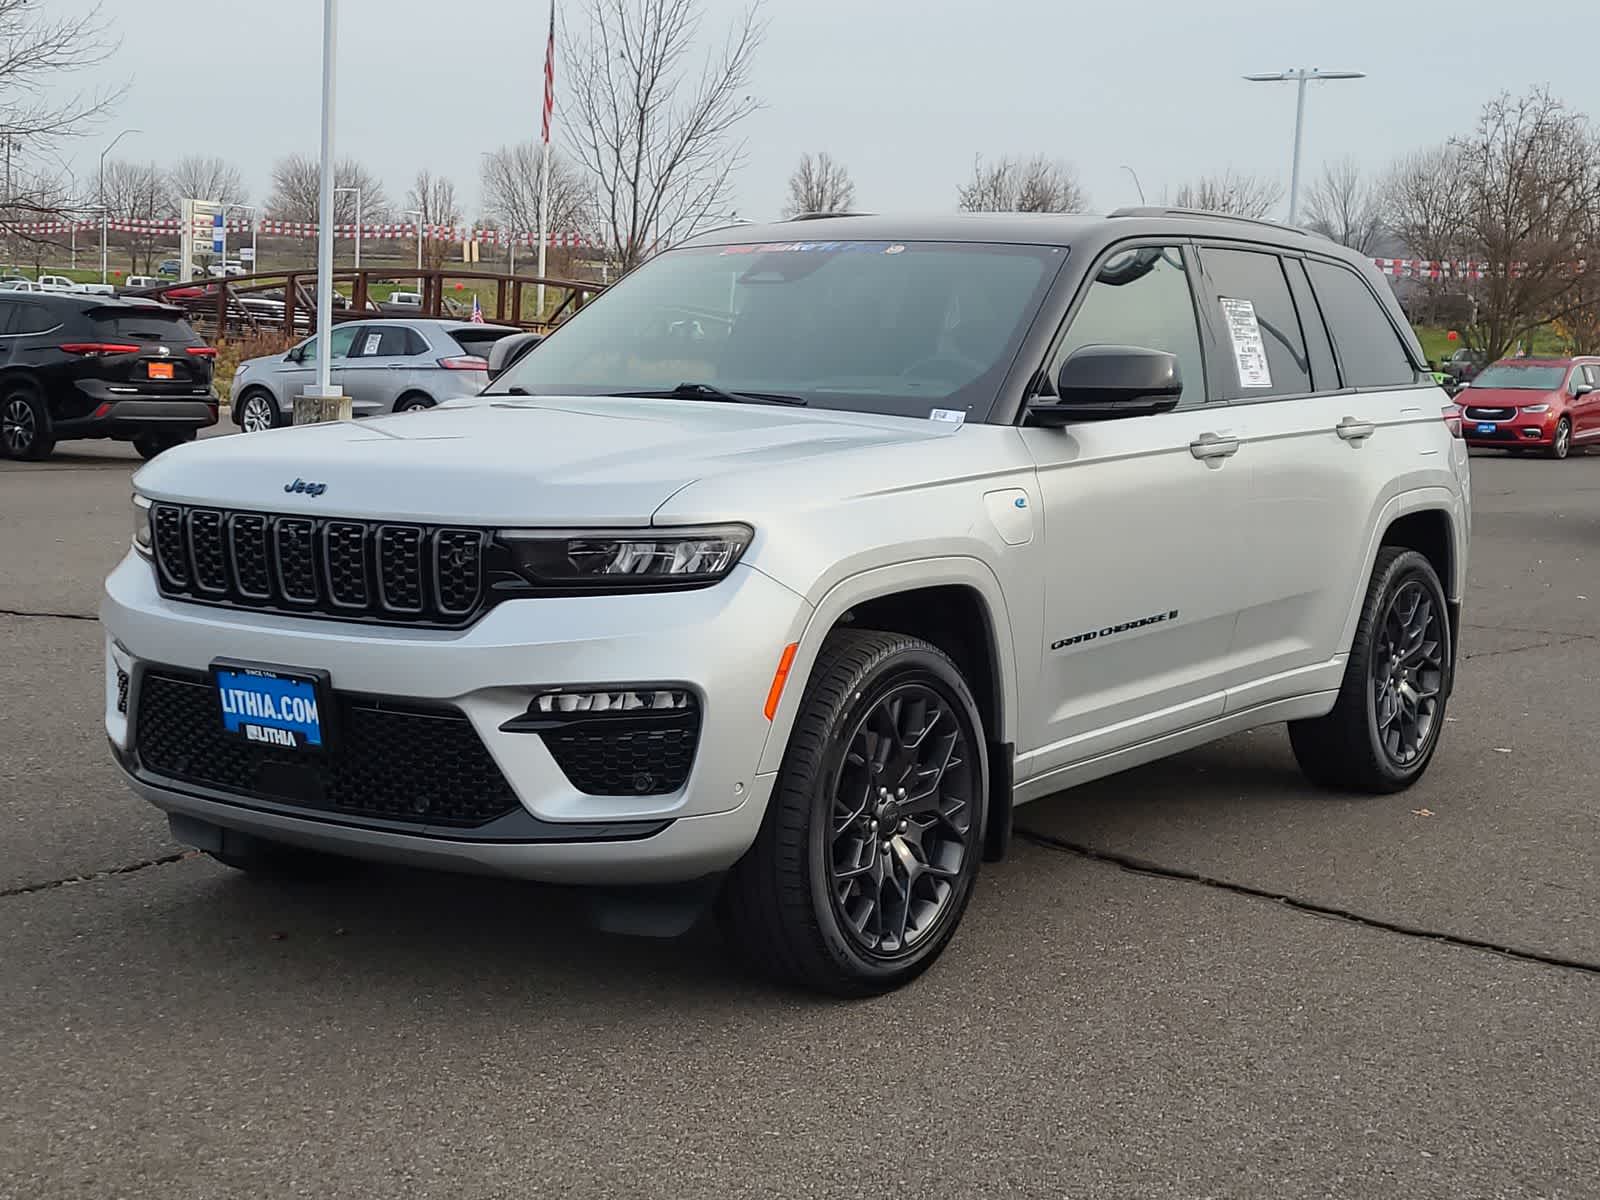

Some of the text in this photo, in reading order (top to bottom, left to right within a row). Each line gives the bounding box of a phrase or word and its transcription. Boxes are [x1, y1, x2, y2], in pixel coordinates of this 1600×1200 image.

[284, 478, 327, 498] Jeep
[1051, 612, 1167, 650] GRAND CHEROKEE
[220, 687, 319, 725] LITHIA.COM
[256, 726, 296, 747] LITHIA
